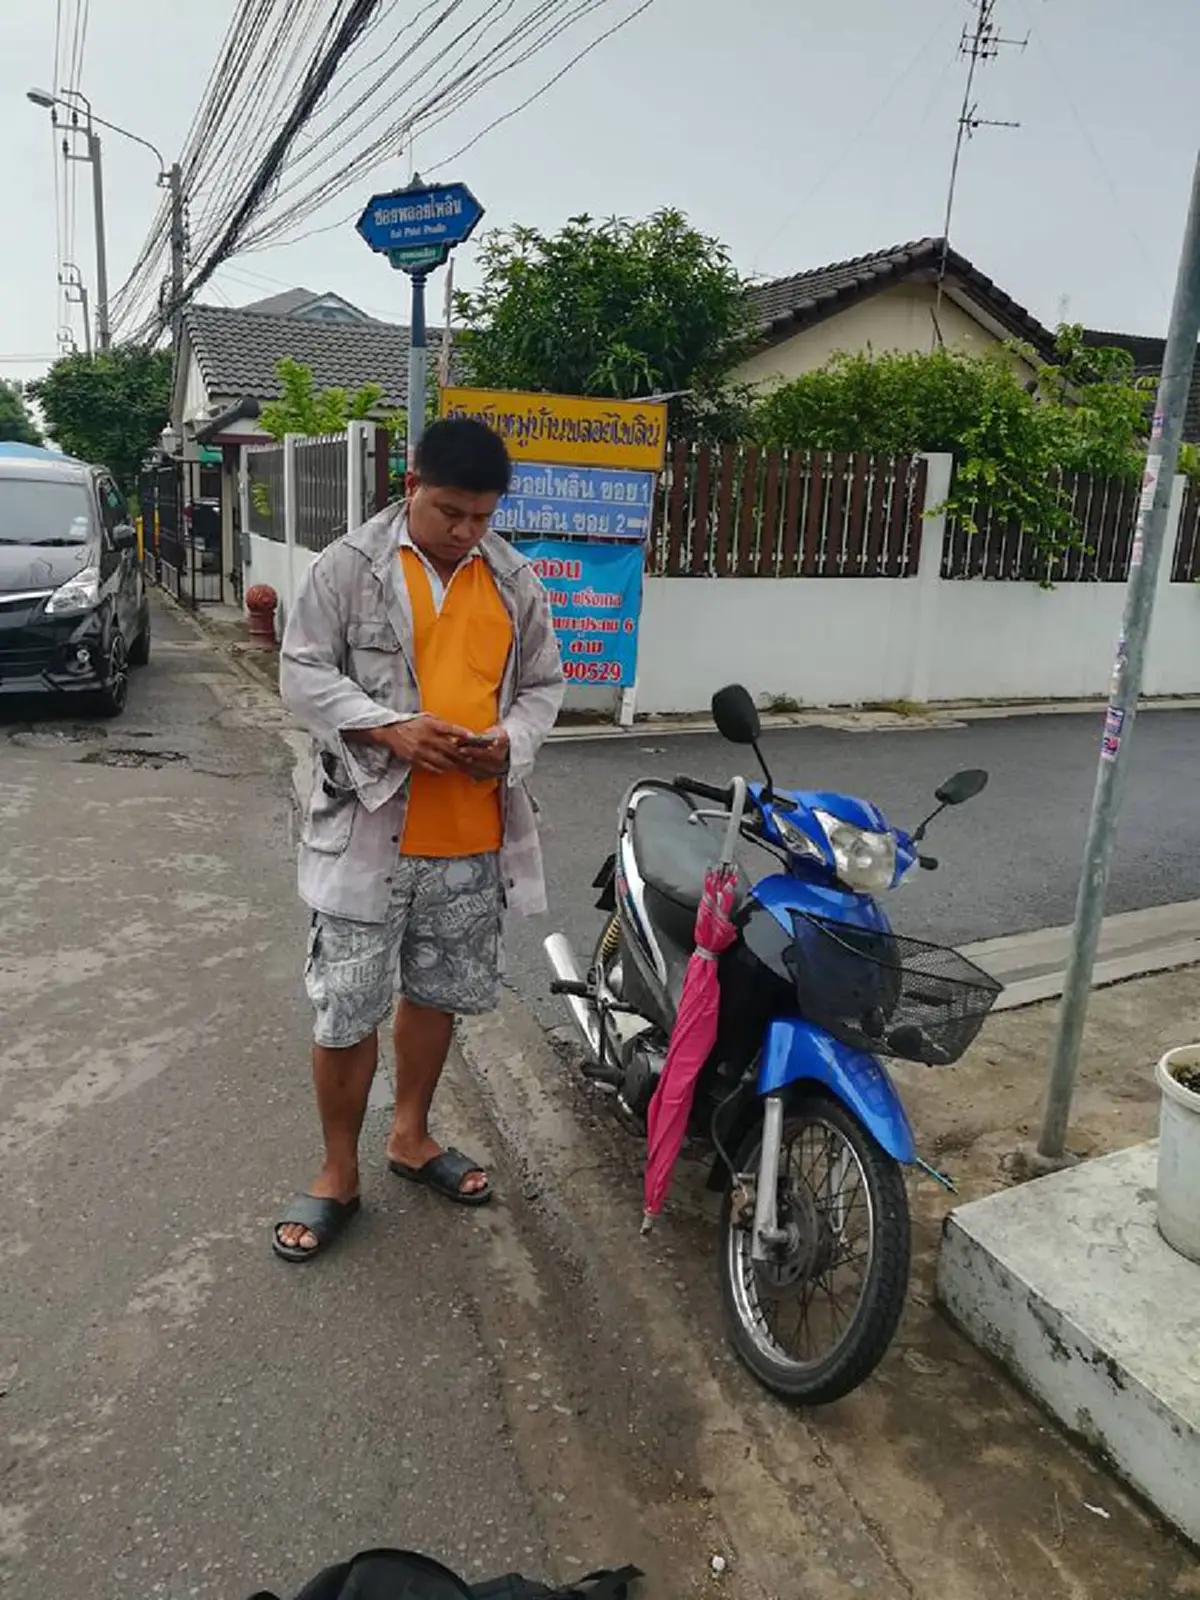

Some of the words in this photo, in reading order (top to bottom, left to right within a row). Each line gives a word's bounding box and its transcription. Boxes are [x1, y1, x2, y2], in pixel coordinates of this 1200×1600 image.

[374, 192, 463, 226] ซอยพลอยไพลิน
[509, 468, 595, 499] ลอยไพลิน
[493, 500, 568, 531] อยไพลิน
[573, 511, 610, 534] ซอย
[615, 513, 626, 534] 2
[623, 617, 634, 633] 6
[562, 661, 621, 682] 90529
